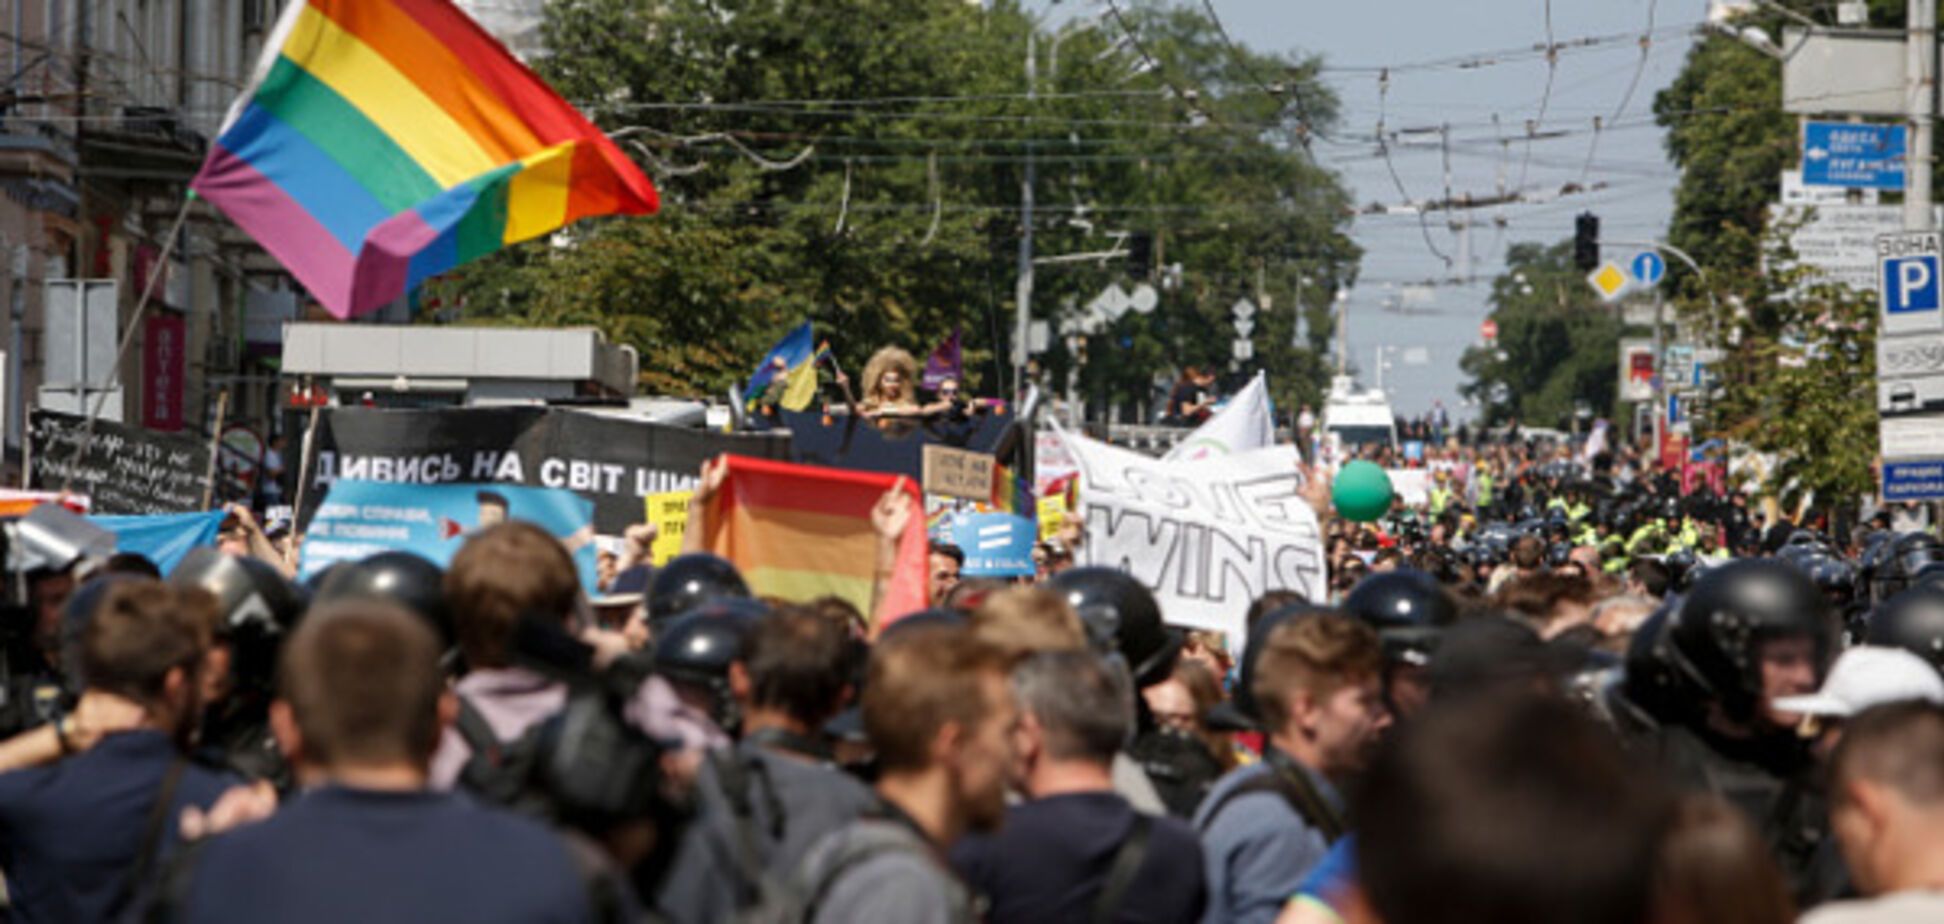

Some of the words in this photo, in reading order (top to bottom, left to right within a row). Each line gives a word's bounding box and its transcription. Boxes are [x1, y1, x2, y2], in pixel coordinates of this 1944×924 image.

[1878, 233, 1938, 256] ЗОНА
[1899, 261, 1930, 308] P
[312, 450, 462, 488] ДИВИСЬ
[470, 450, 524, 481] НА
[540, 456, 625, 494] СВІТ
